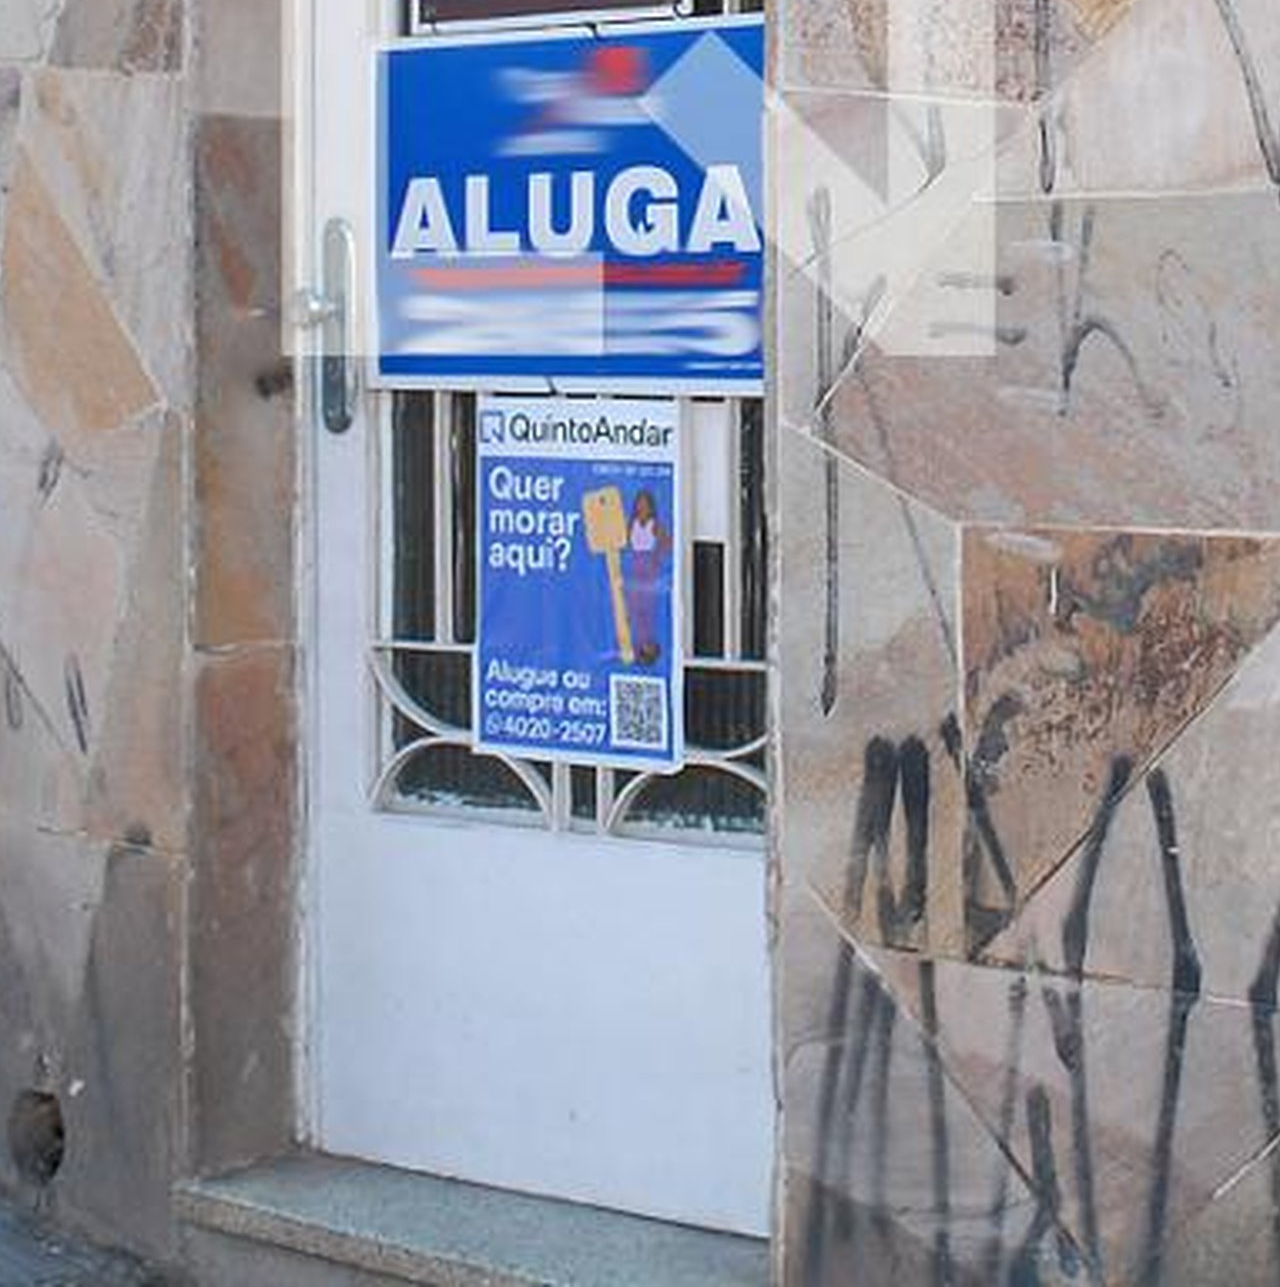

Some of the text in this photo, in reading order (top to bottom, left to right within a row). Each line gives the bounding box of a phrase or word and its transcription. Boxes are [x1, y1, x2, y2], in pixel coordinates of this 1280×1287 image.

[390, 163, 762, 261] ALUGA
[508, 412, 674, 447] QuintoAndar
[489, 465, 565, 502] Quer
[489, 508, 580, 536] morar
[488, 539, 571, 577] aqui?
[562, 669, 591, 689] ou
